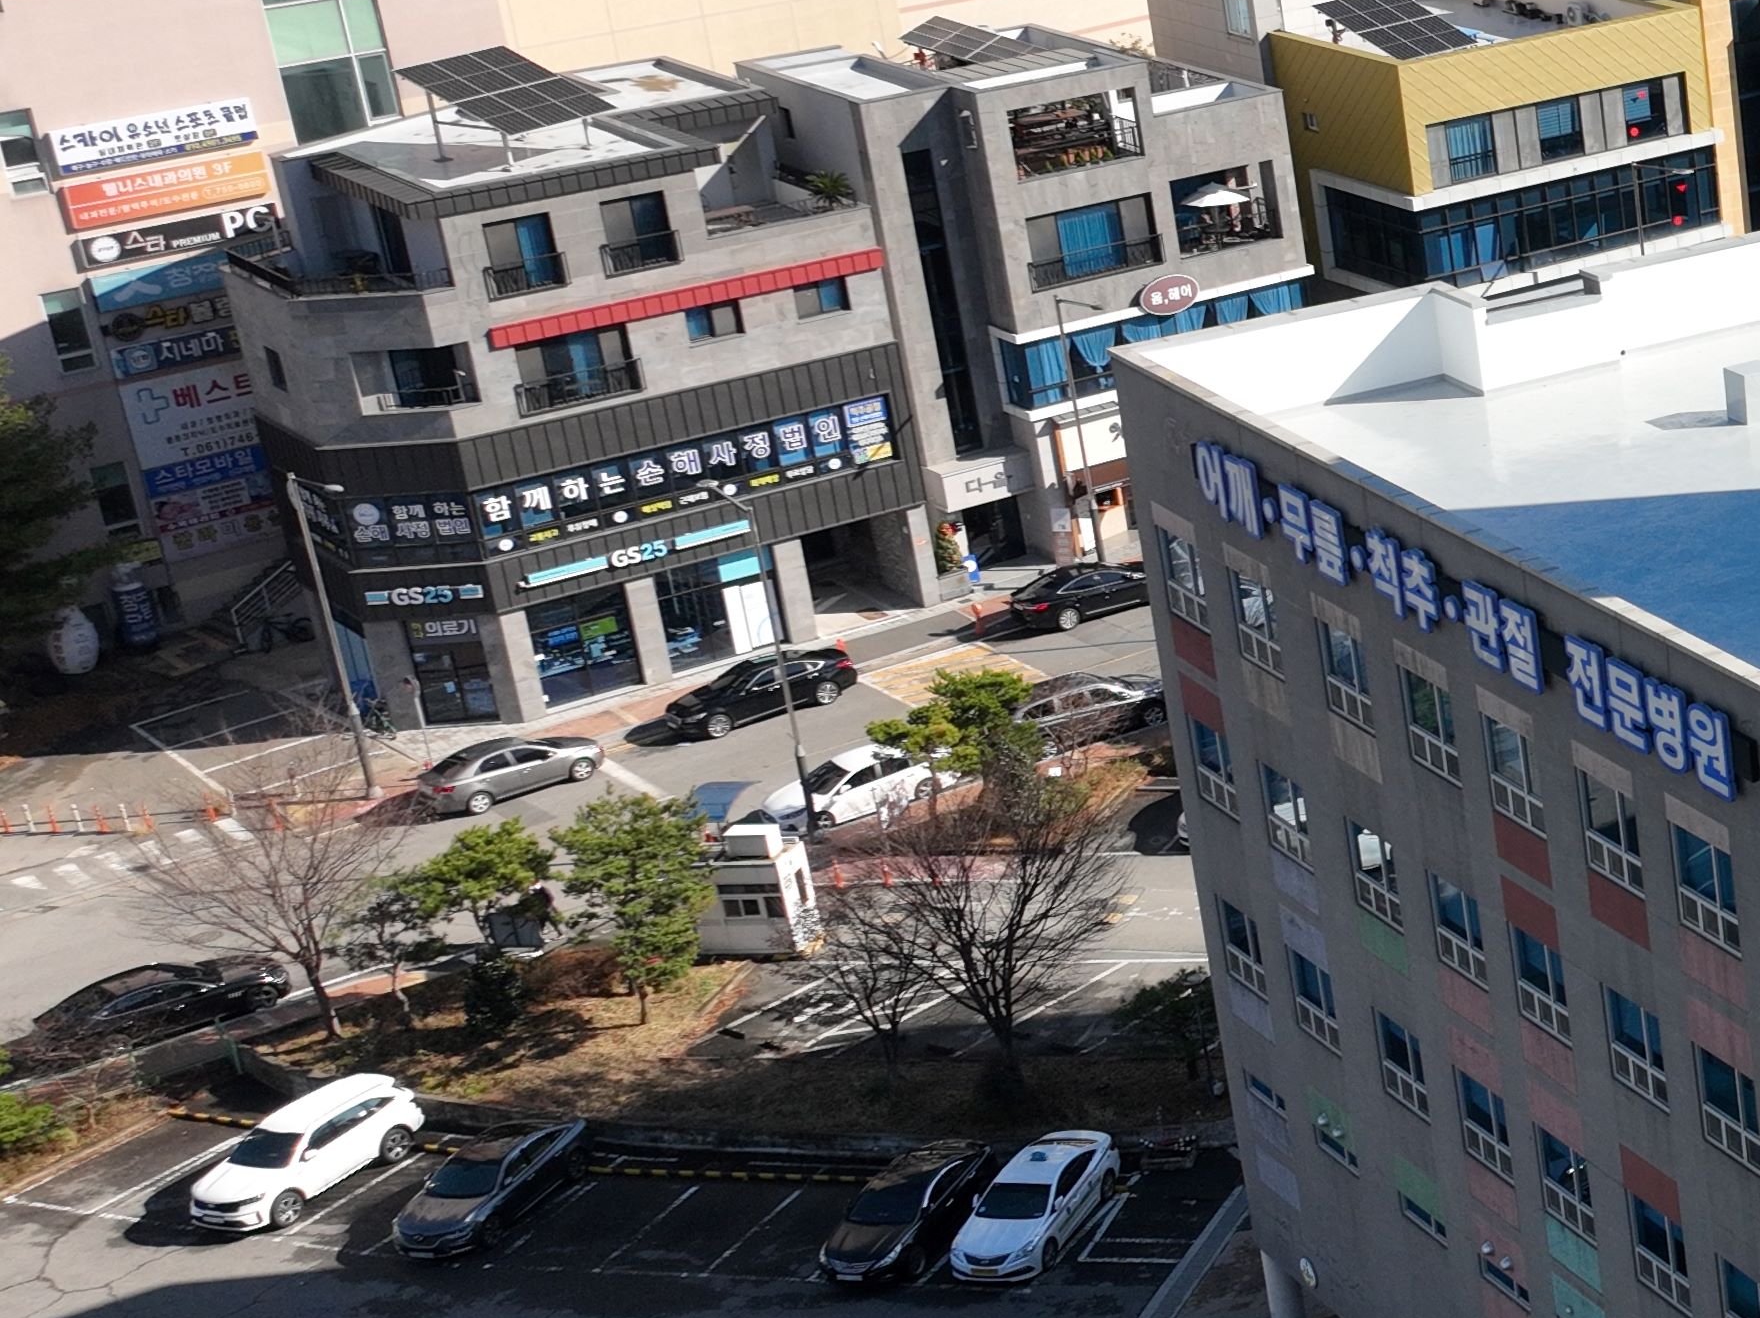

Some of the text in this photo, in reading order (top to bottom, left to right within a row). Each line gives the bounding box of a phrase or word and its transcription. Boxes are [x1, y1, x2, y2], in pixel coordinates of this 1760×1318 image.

[59, 103, 249, 152] 스카이 유소년 스포츠 클럽
[212, 162, 233, 177] 3F
[124, 204, 274, 252] 스타 PREMIUM PC
[145, 305, 189, 330] 스타
[160, 332, 225, 363] 시네마
[155, 448, 254, 486] 스타모바일
[392, 501, 466, 520] 함께 하는
[354, 518, 472, 543] 손해 사정 법인
[611, 540, 668, 568] GS25
[391, 587, 454, 606] GS25
[424, 620, 477, 637] 의료기
[1564, 633, 1738, 803] 전문병원
